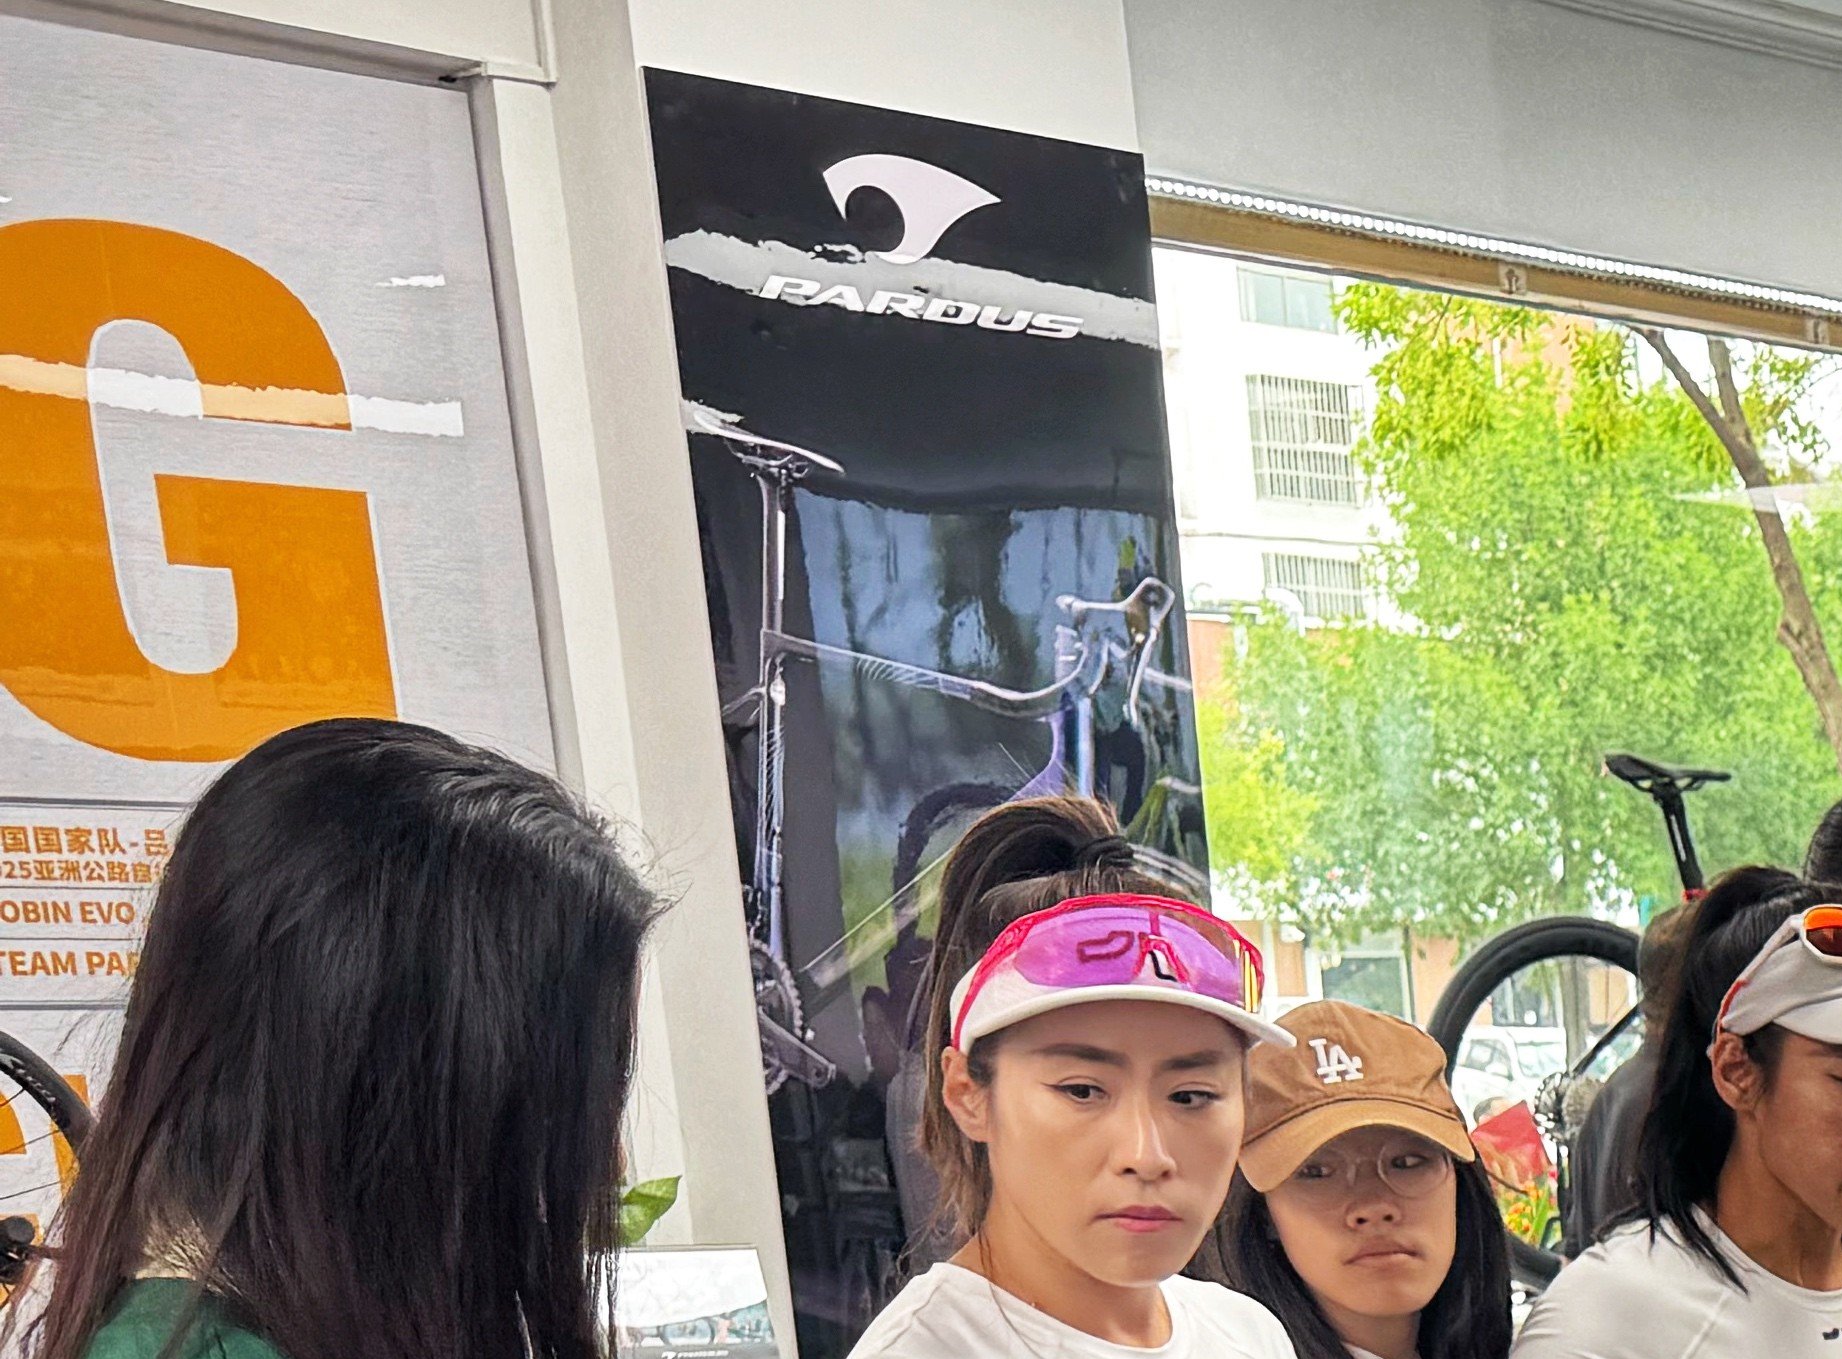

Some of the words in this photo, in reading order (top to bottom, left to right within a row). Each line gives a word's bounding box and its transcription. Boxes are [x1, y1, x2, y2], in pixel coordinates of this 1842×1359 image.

[758, 275, 1084, 339] PARDUS
[80, 901, 136, 925] EVO
[1308, 1038, 1364, 1084] LA
